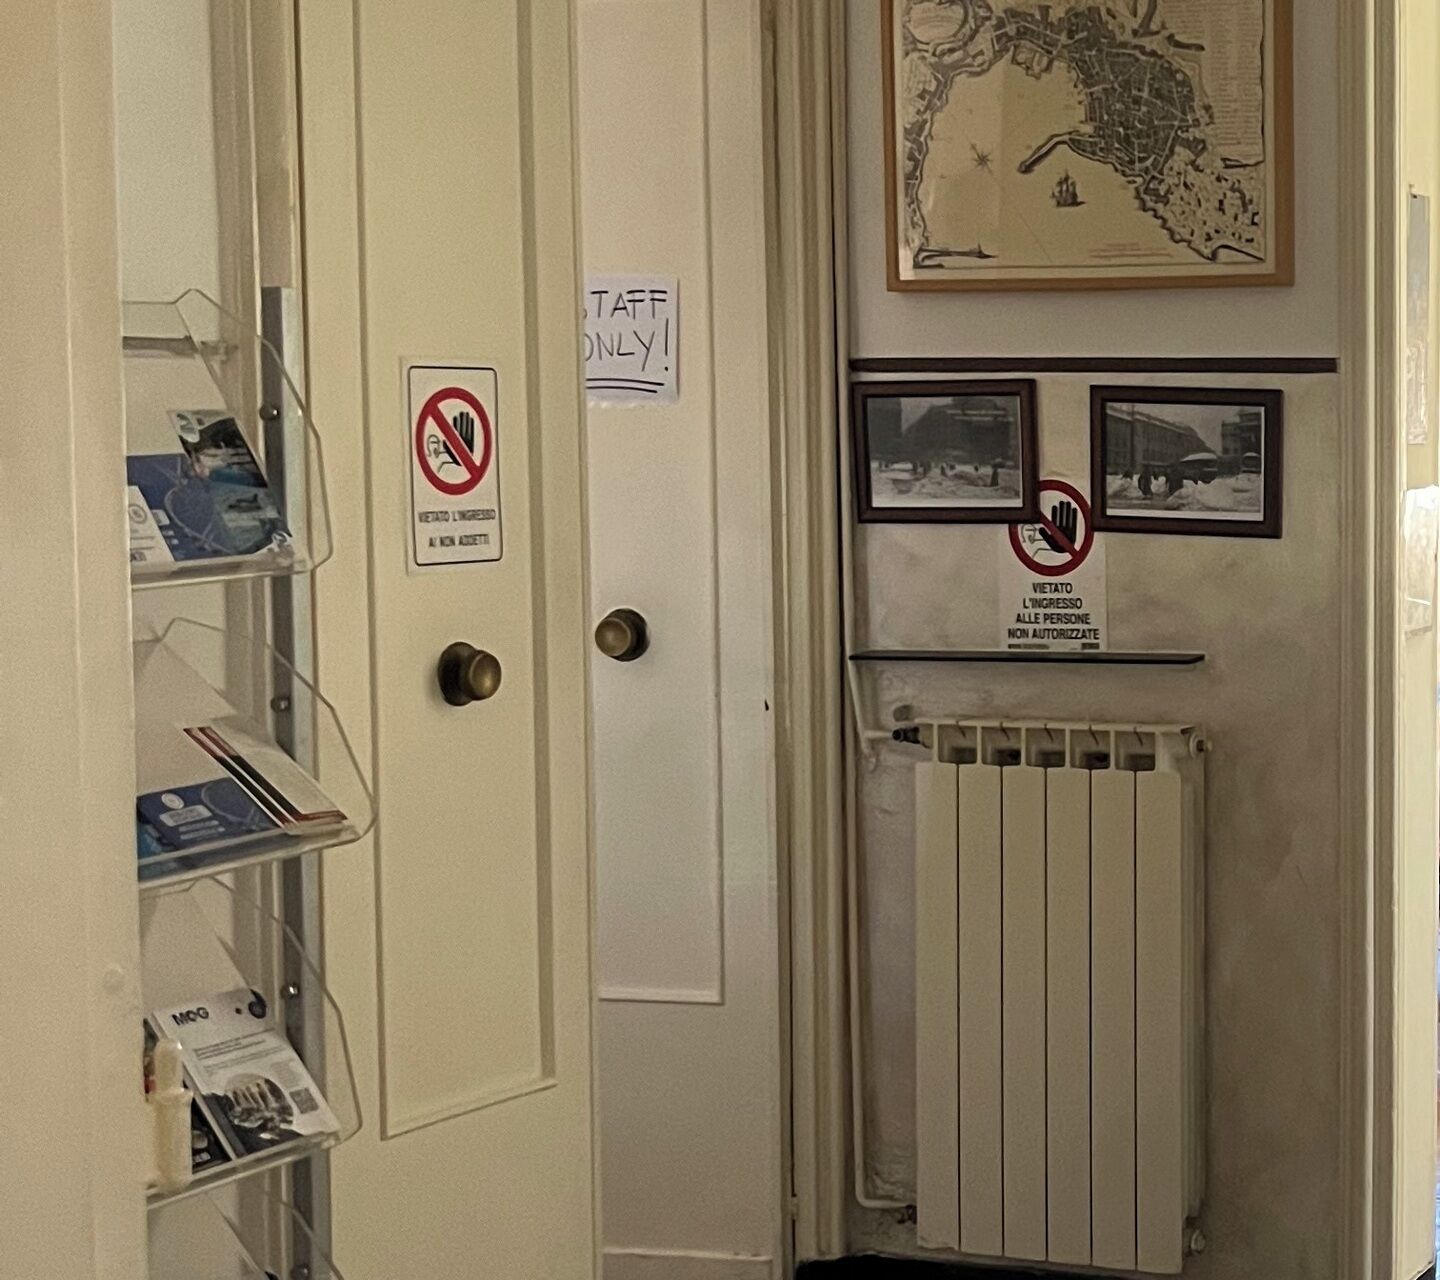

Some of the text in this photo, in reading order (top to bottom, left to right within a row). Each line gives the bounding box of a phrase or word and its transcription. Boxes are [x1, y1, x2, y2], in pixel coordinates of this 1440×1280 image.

[583, 289, 668, 320] TAFF
[1032, 582, 1073, 594] VIETATO
[1022, 597, 1083, 610] L'INGRESSO
[1015, 613, 1092, 625] ALLE PERSONE
[1007, 628, 1100, 640] NON AUTORIZZATE
